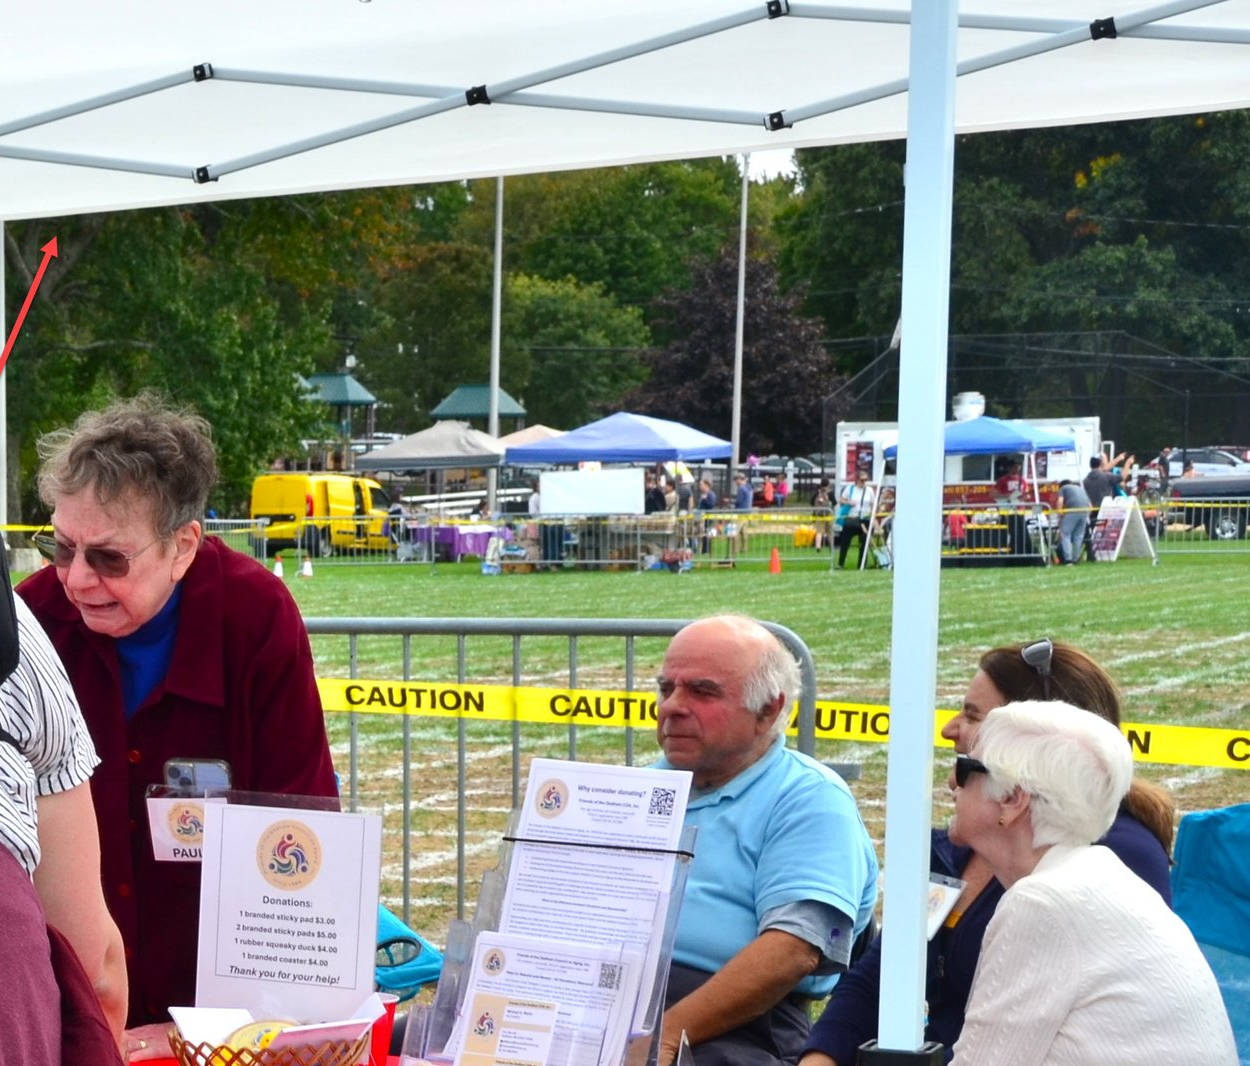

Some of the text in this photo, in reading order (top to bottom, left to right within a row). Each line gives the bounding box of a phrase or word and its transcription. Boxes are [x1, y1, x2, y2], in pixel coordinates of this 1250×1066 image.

[345, 685, 484, 711] CAUTION
[550, 695, 658, 721] CAUTI
[262, 896, 312, 908] Donations:
[245, 911, 275, 919] branded
[276, 914, 298, 922] sticky
[300, 916, 313, 924] pad
[316, 917, 335, 925] $3.00
[242, 925, 272, 933] branded
[274, 928, 295, 936] sticky
[317, 931, 336, 939] $5.00
[266, 941, 296, 950] squeaky
[318, 945, 337, 953] $4.00
[248, 953, 277, 962] branded
[230, 965, 340, 984] Thank you for your help!
